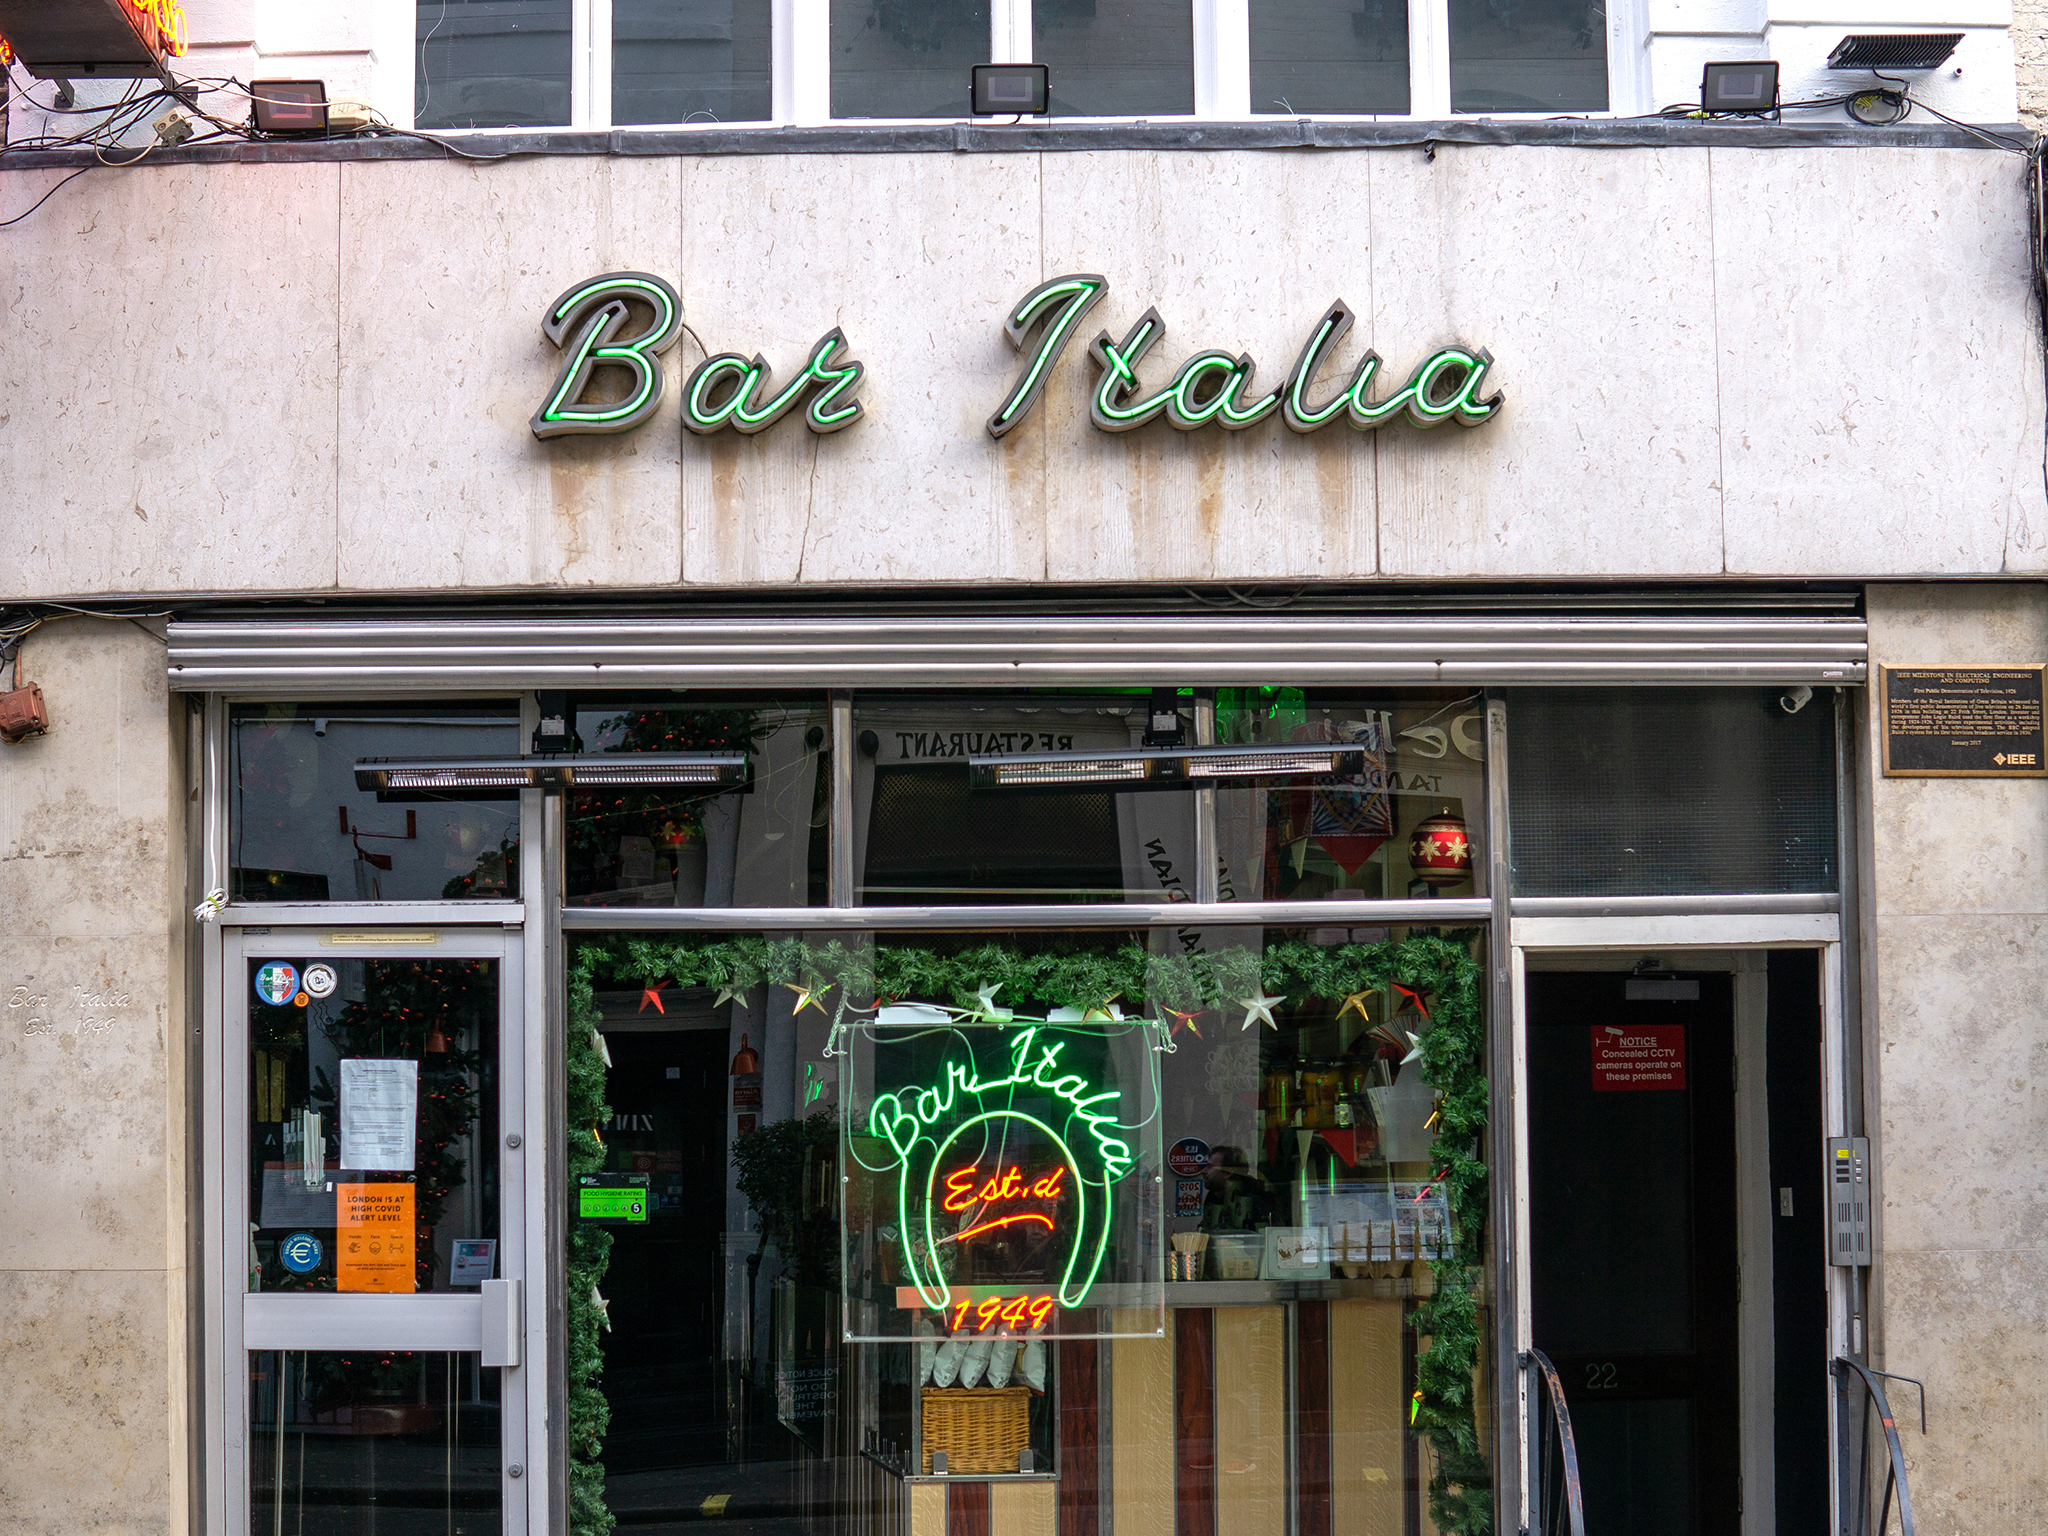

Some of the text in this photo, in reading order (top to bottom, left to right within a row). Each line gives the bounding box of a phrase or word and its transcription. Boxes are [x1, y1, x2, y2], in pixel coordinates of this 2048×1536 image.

[530, 271, 1506, 441] Bar Italia
[2007, 754, 2036, 764] IEEE
[8, 984, 132, 1008] Bar Italia
[24, 1016, 116, 1037] Est. 1949
[1619, 1037, 1657, 1047] NOTICE
[1602, 1048, 1675, 1058] Concealed CCTV
[1596, 1062, 1633, 1070] cameras
[1635, 1061, 1668, 1070] operate
[1606, 1072, 1672, 1082] these premises
[870, 1026, 1132, 1177] Bar Italia
[633, 1204, 640, 1213] 5
[952, 1295, 1053, 1331] 1949
[1586, 1362, 1618, 1388] 22
